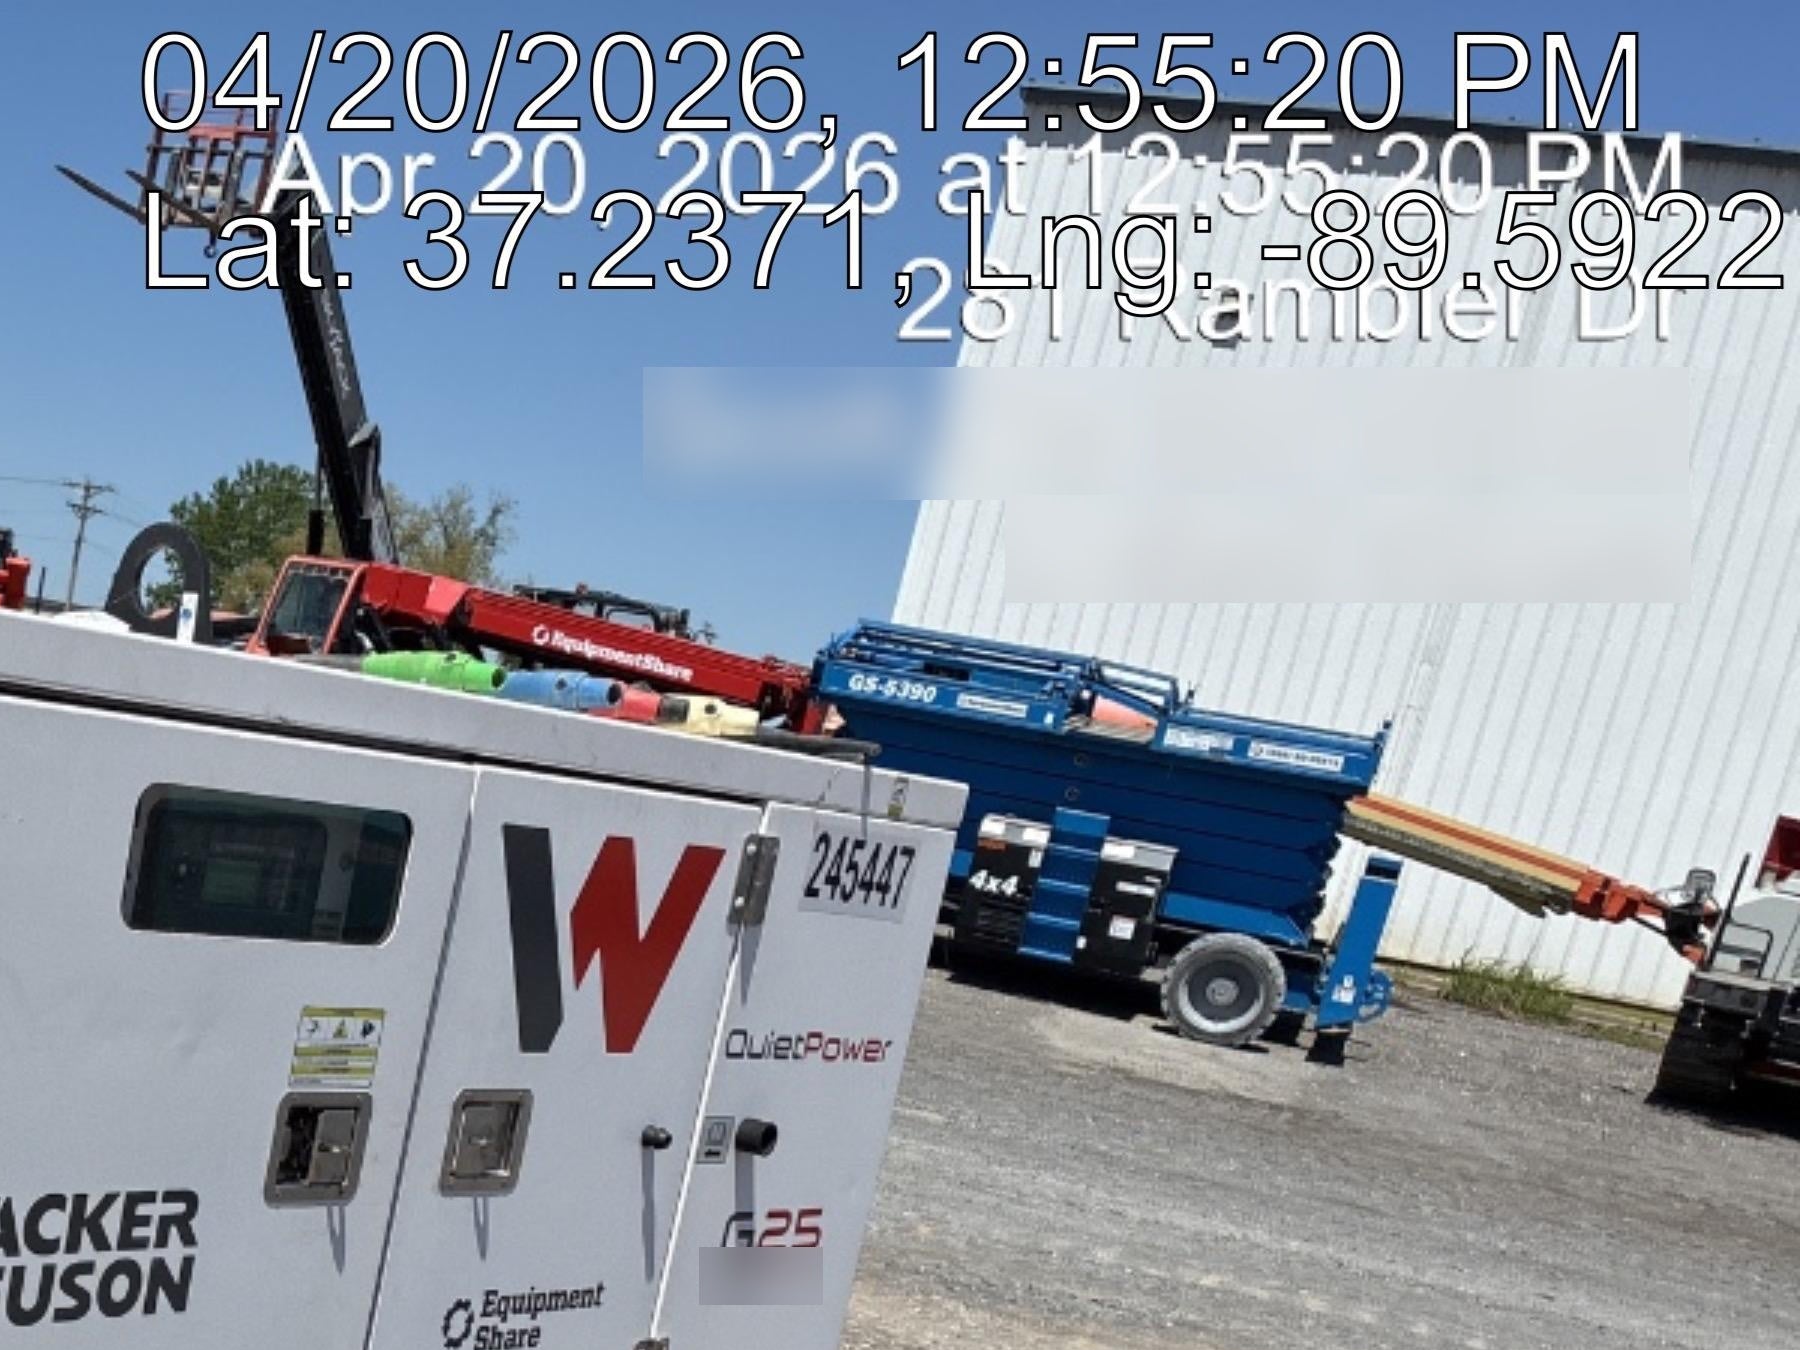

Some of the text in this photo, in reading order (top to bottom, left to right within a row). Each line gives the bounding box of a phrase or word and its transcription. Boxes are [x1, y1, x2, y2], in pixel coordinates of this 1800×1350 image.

[848, 672, 938, 704] GS-5390
[803, 831, 916, 910] 245447
[968, 868, 1020, 897] 4x4
[725, 1027, 893, 1063] QuietPower
[479, 1280, 606, 1323] Equipment
